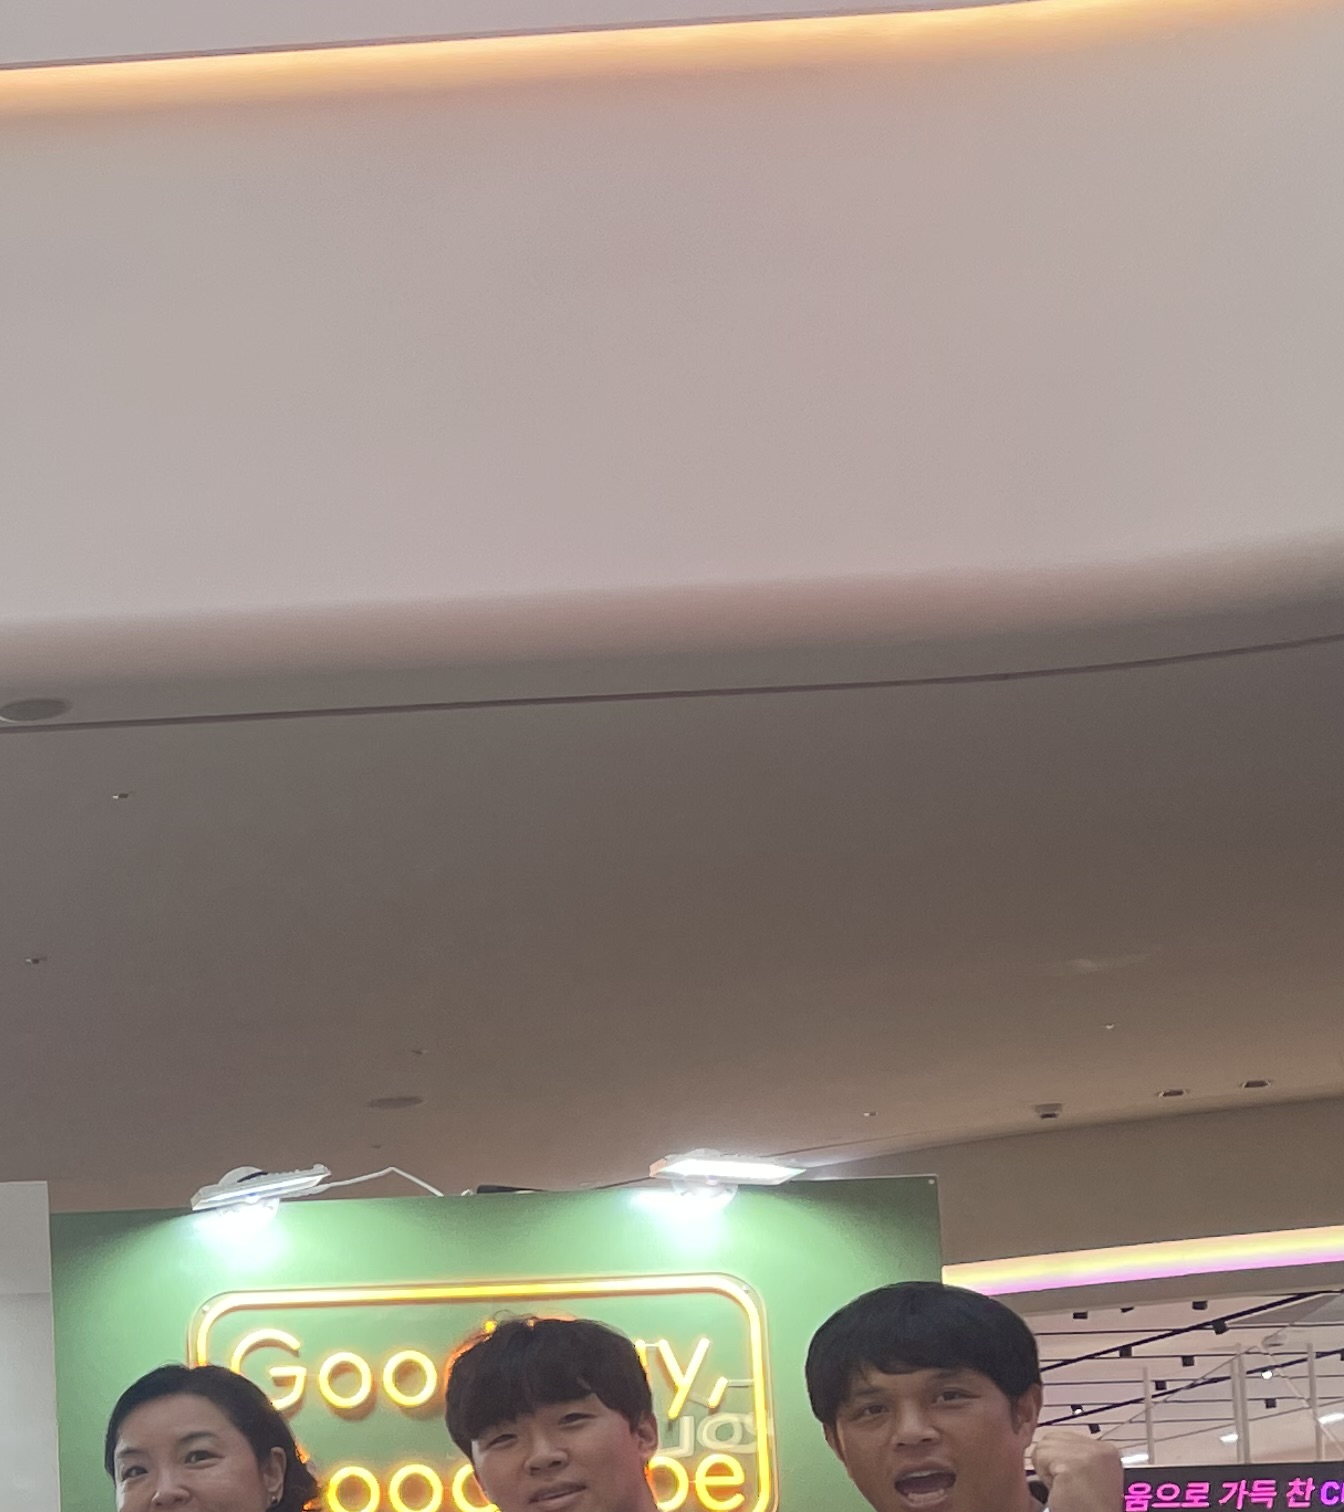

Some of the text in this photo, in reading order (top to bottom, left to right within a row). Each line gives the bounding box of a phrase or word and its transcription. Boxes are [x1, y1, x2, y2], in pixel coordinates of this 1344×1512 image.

[231, 1323, 494, 1410] Goo
[1218, 1479, 1277, 1510] 가득
[1286, 1478, 1315, 1508] 찬
